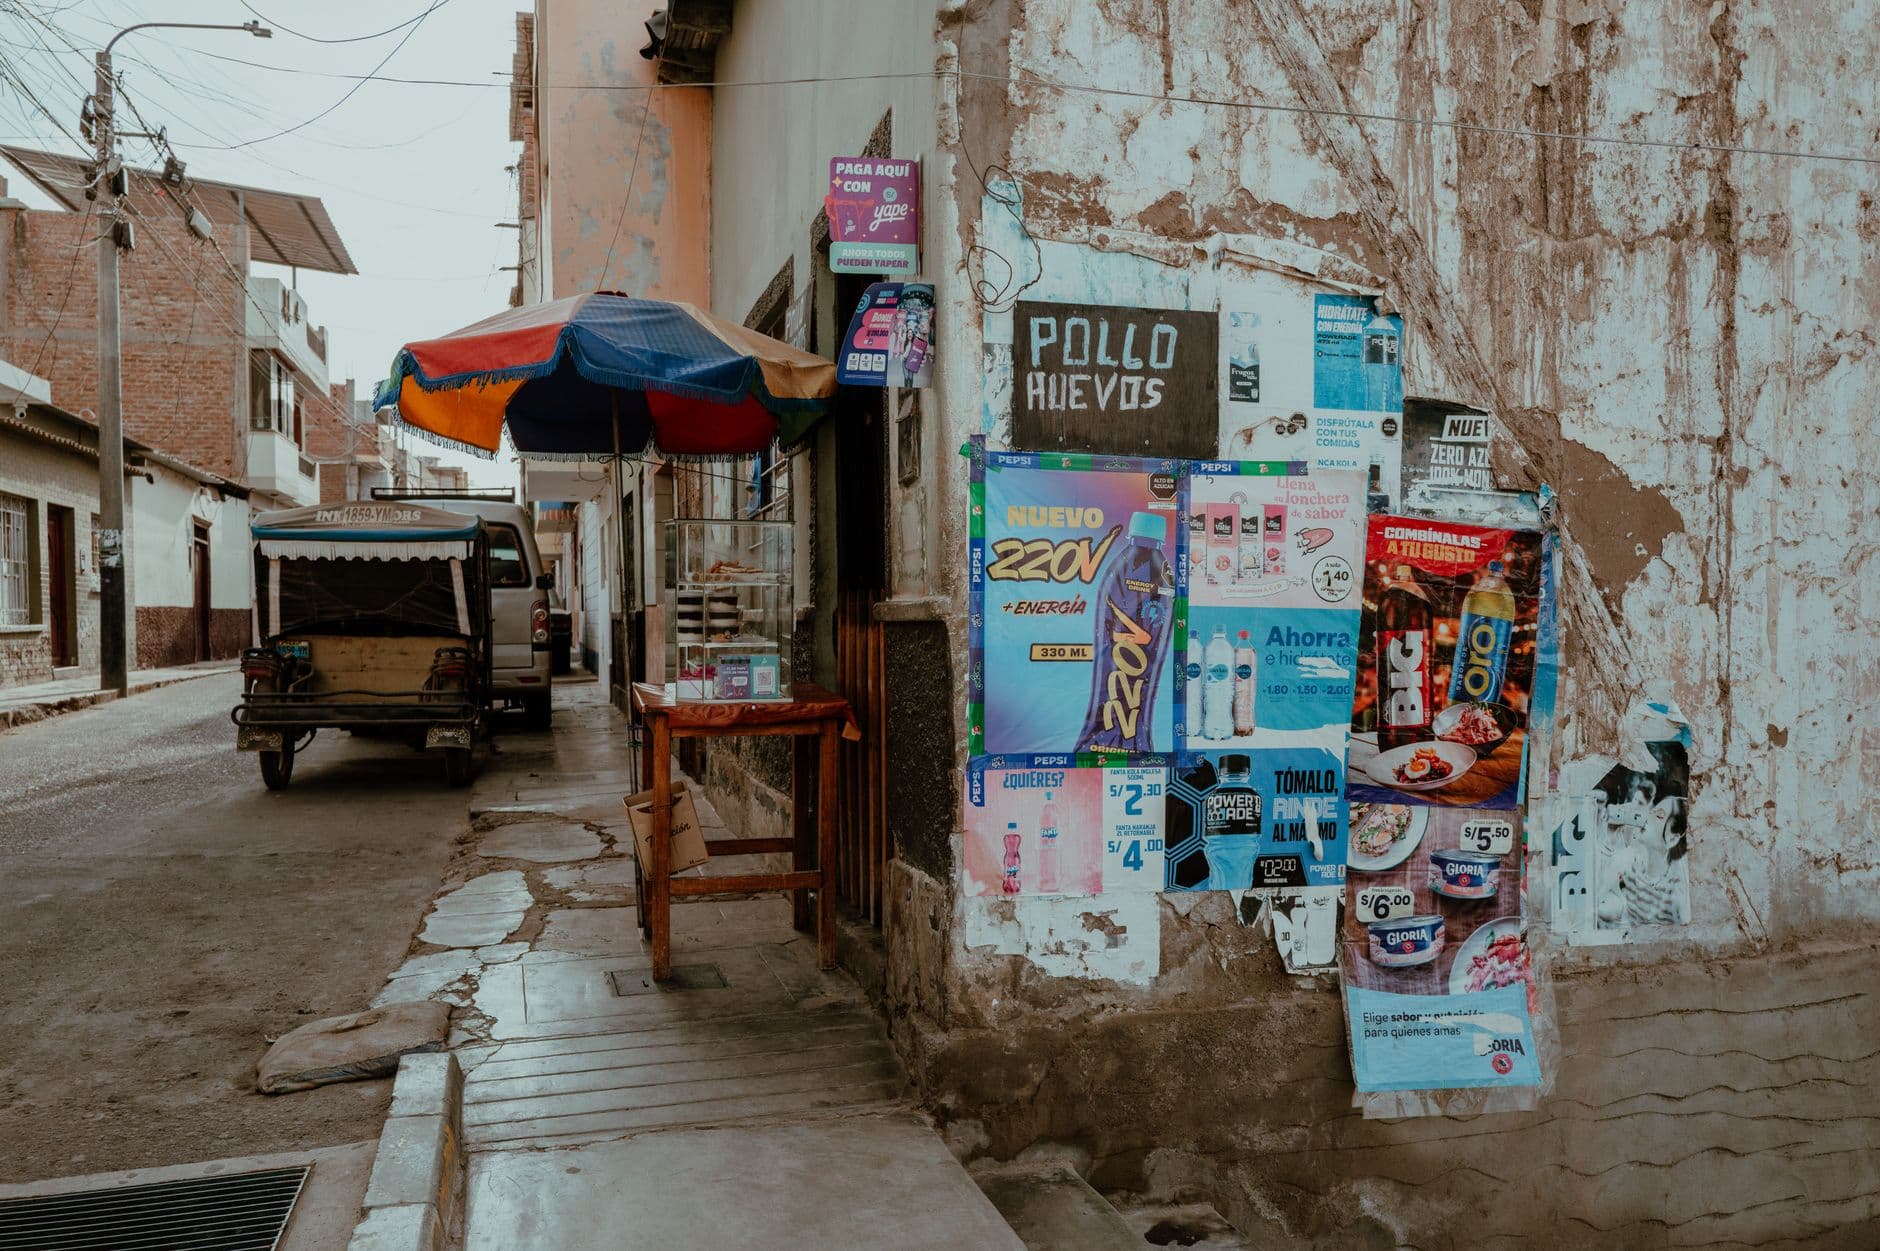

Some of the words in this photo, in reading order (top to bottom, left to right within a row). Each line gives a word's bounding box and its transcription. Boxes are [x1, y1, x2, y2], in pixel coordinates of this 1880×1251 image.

[836, 163, 872, 175] PAGA
[875, 163, 910, 178] AQUÍ
[843, 181, 871, 192] CON
[869, 203, 908, 232] yape
[842, 249, 873, 258] AHORA
[876, 250, 905, 258] TODOS
[837, 258, 872, 267] PUEDEN
[874, 259, 909, 268] YAPEAR
[1317, 304, 1368, 321] HIDRÁTATE
[1030, 317, 1178, 369] POLLO
[1027, 371, 1165, 411] HUEVOS
[1317, 417, 1374, 428] DISFRÚTALA
[1316, 429, 1337, 437] CON
[1316, 439, 1360, 448] COMIDAS
[998, 455, 1031, 465] PEPSI
[1431, 444, 1464, 465] ZERO
[1201, 463, 1232, 473] PEPSI
[1277, 475, 1316, 491] Llena
[1286, 490, 1349, 504] lonchera
[1007, 505, 1104, 529] NUEVO
[1305, 507, 1346, 519] sabor
[1384, 526, 1481, 549] COMBÍNALAS
[987, 524, 1122, 584] 220V
[1387, 541, 1399, 555] A
[1401, 542, 1421, 559] TU
[1423, 545, 1475, 563] GUSTO
[973, 548, 981, 583] PEPSI
[1126, 580, 1154, 588] ENERGY
[1266, 626, 1350, 647] Ahorra
[1041, 648, 1065, 657] 330
[1070, 648, 1087, 657] ML
[1266, 654, 1275, 665] e
[1103, 595, 1152, 739] 220V
[1389, 631, 1424, 726] BIG
[1034, 757, 1067, 765] PEPSI
[1003, 772, 1064, 789] ¿QUIERES?
[1274, 766, 1338, 795] TÓMALO,
[1207, 794, 1254, 808] POWER
[1226, 808, 1254, 820] ADE
[1272, 823, 1287, 842] AL
[1289, 819, 1336, 842] MÁMO
[1446, 863, 1484, 878] GLORIA
[1387, 929, 1428, 945] GLORIA
[1363, 1012, 1389, 1025] Elige
[1391, 1012, 1422, 1022] sabor
[1364, 1027, 1388, 1040] para
[1391, 1025, 1431, 1039] quienes
[1434, 1025, 1461, 1036] amas
